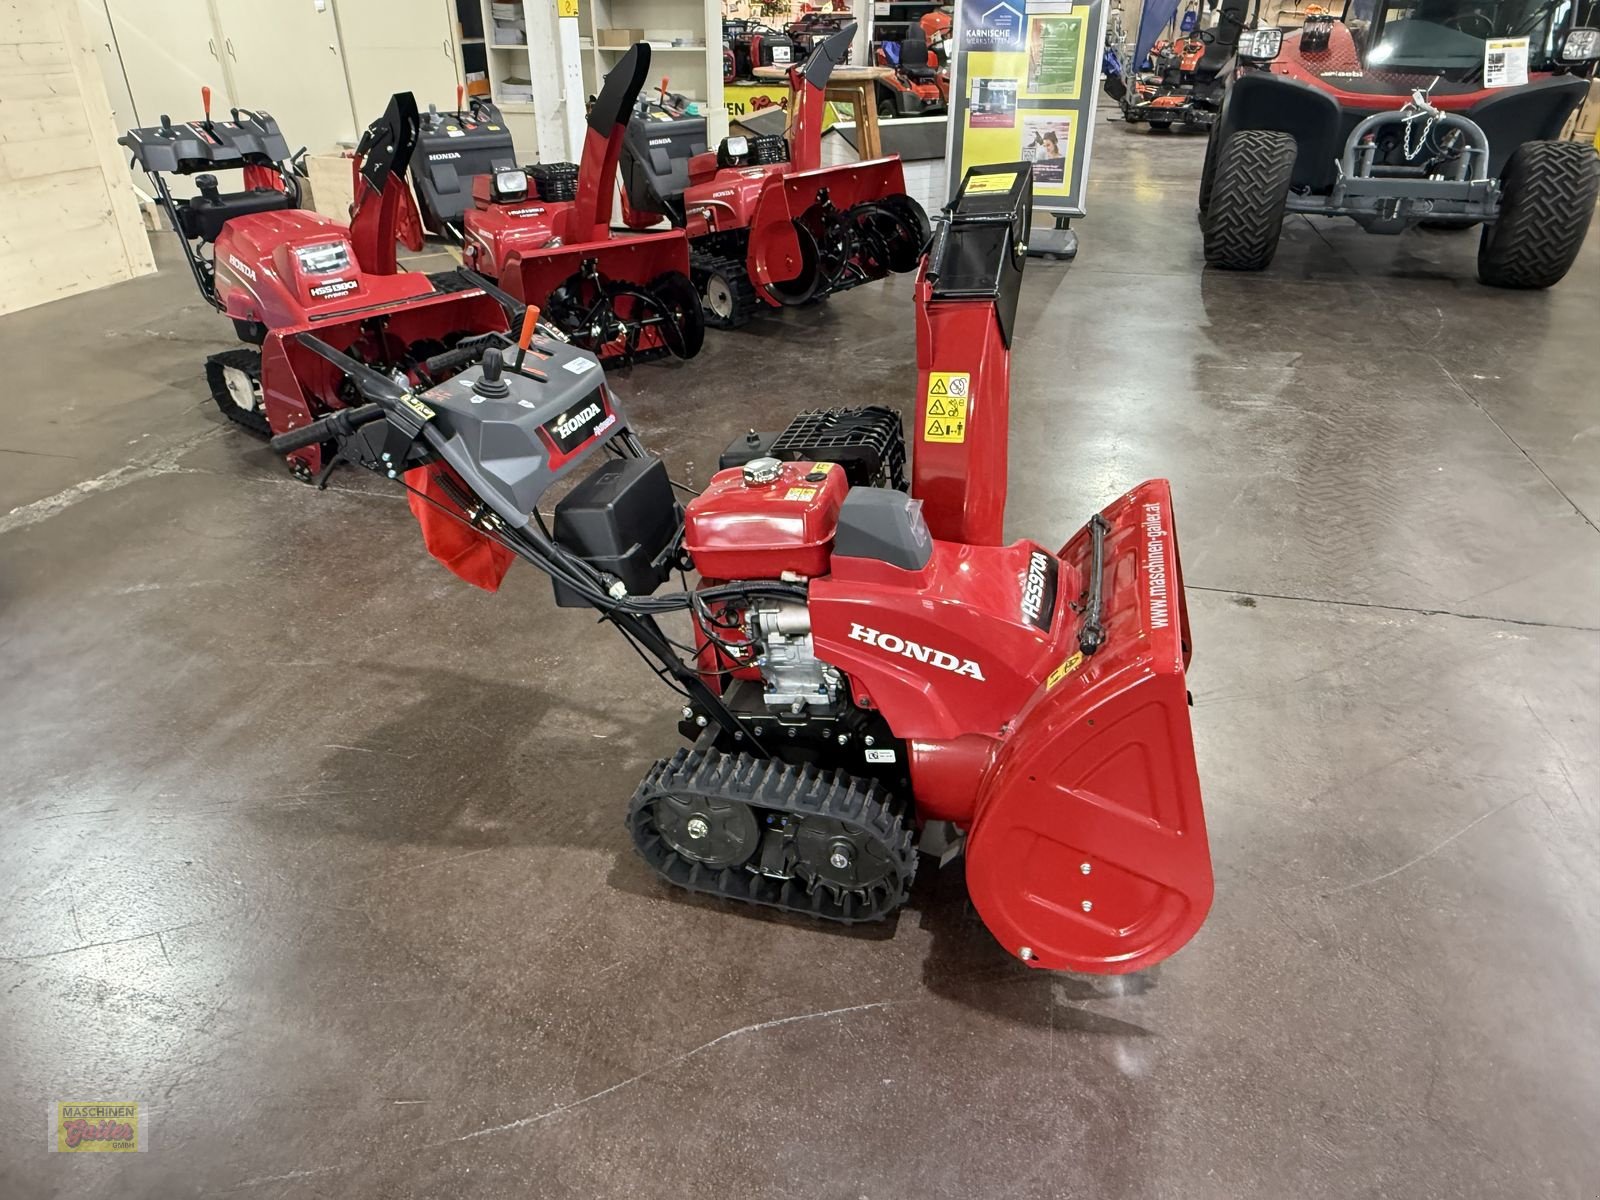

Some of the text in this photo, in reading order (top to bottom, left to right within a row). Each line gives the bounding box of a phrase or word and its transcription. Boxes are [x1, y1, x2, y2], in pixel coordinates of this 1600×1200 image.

[966, 29, 1010, 37] KARNISCHE
[648, 137, 672, 145] HONDA
[429, 152, 461, 160] HONDA
[712, 189, 735, 199] HONDA
[229, 254, 257, 282] HONDA
[557, 402, 601, 440] HONDA
[1141, 502, 1169, 629] www.maschinen-gailer.at
[1021, 551, 1048, 620] HSS970A
[847, 622, 986, 681] HONDA
